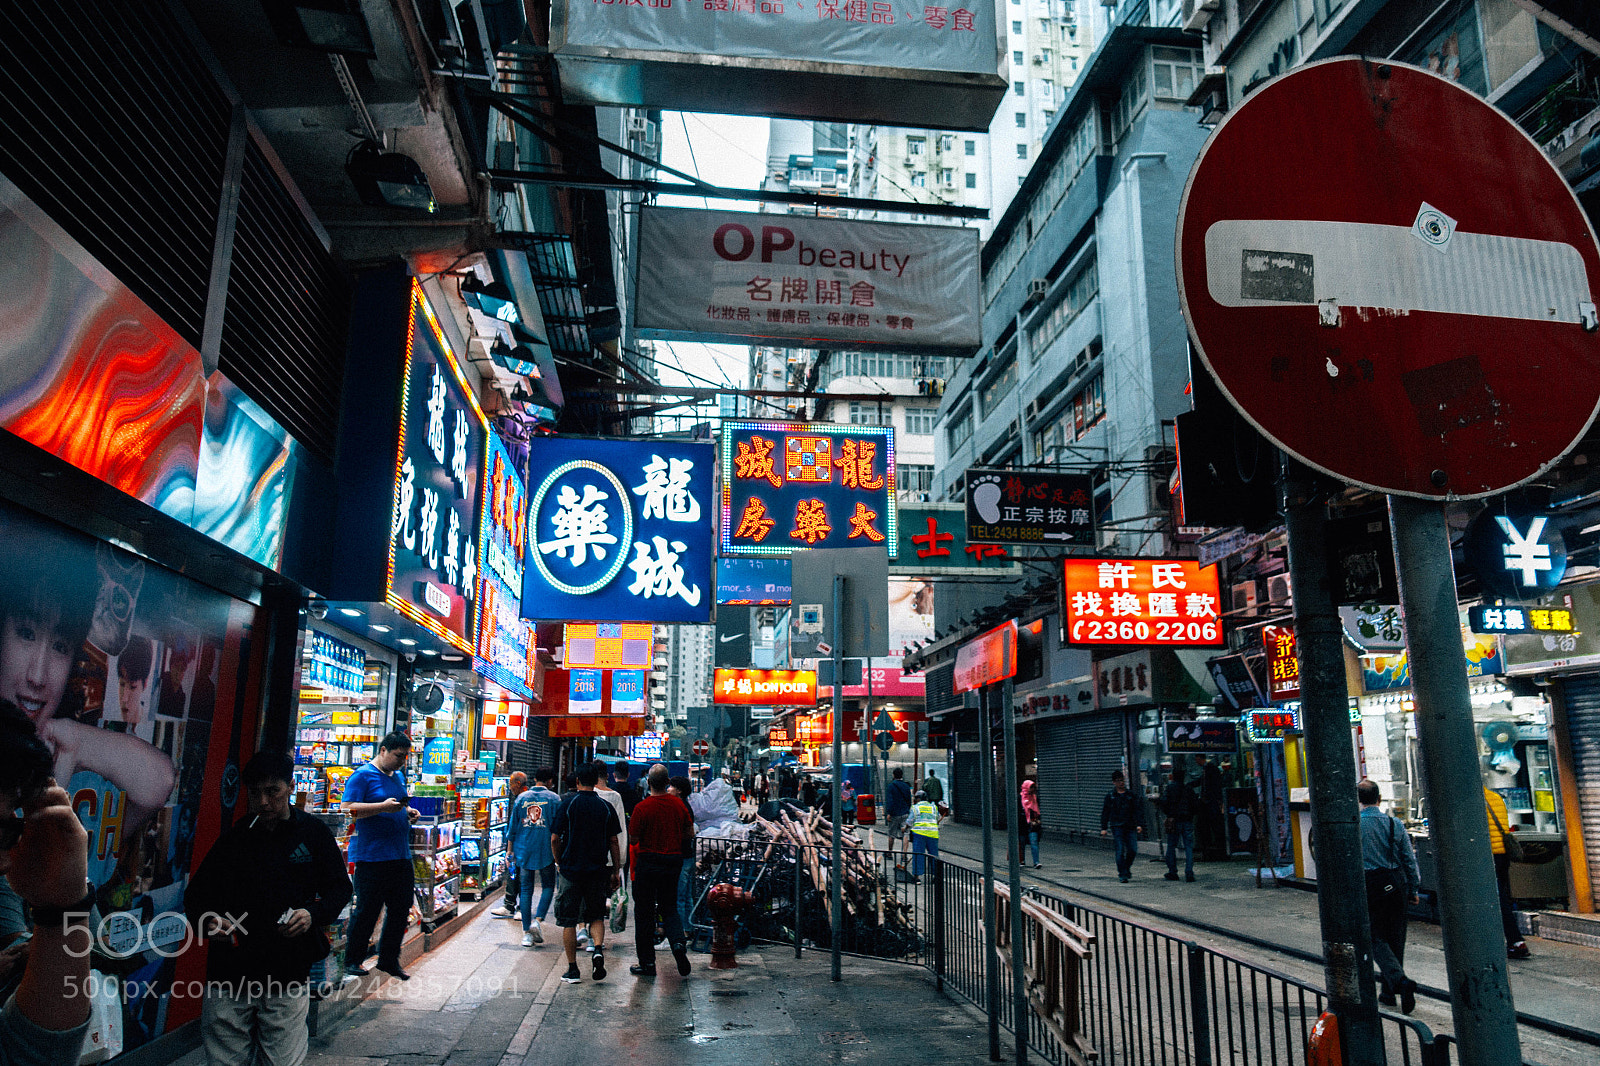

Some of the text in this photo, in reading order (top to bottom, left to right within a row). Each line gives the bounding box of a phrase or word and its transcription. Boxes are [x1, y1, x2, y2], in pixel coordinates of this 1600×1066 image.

[712, 222, 911, 278] OP beauty
[746, 275, 876, 308] 名牌開倉
[537, 483, 618, 568] 藥
[1002, 506, 1091, 526] 正宗按摩
[628, 453, 701, 607] 龍城
[1020, 527, 1044, 541] 8886
[1098, 562, 1187, 590] 許氏
[1071, 591, 1217, 618] 找換匯款
[1088, 621, 1217, 641] 2360 2206
[575, 682, 595, 692] 2018
[617, 682, 637, 692] 2018
[754, 681, 808, 695] BONJOUR
[428, 752, 450, 764] 2018
